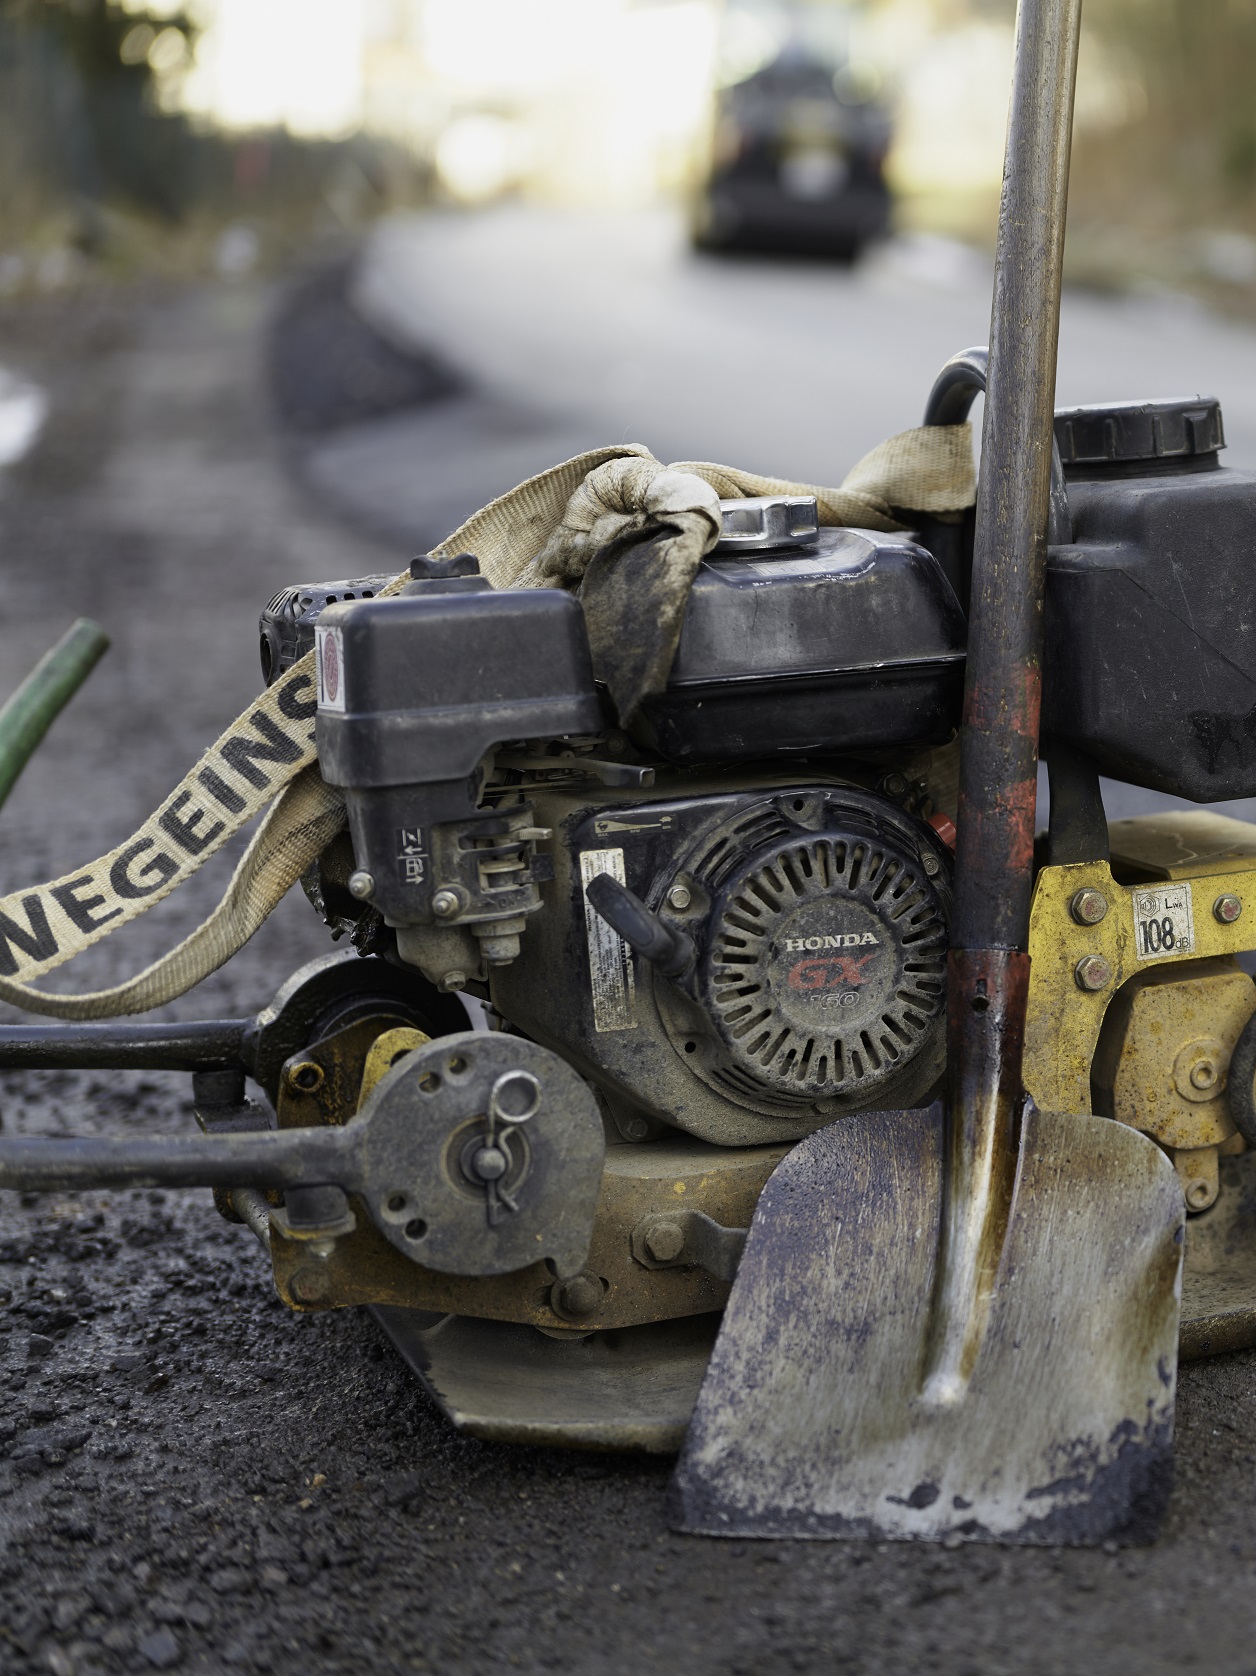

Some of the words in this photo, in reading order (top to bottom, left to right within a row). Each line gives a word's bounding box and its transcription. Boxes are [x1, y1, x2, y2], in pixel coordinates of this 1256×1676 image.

[786, 932, 880, 952] HONDA
[1140, 917, 1175, 953] 108
[1176, 937, 1189, 949] dB
[788, 953, 878, 990] GX
